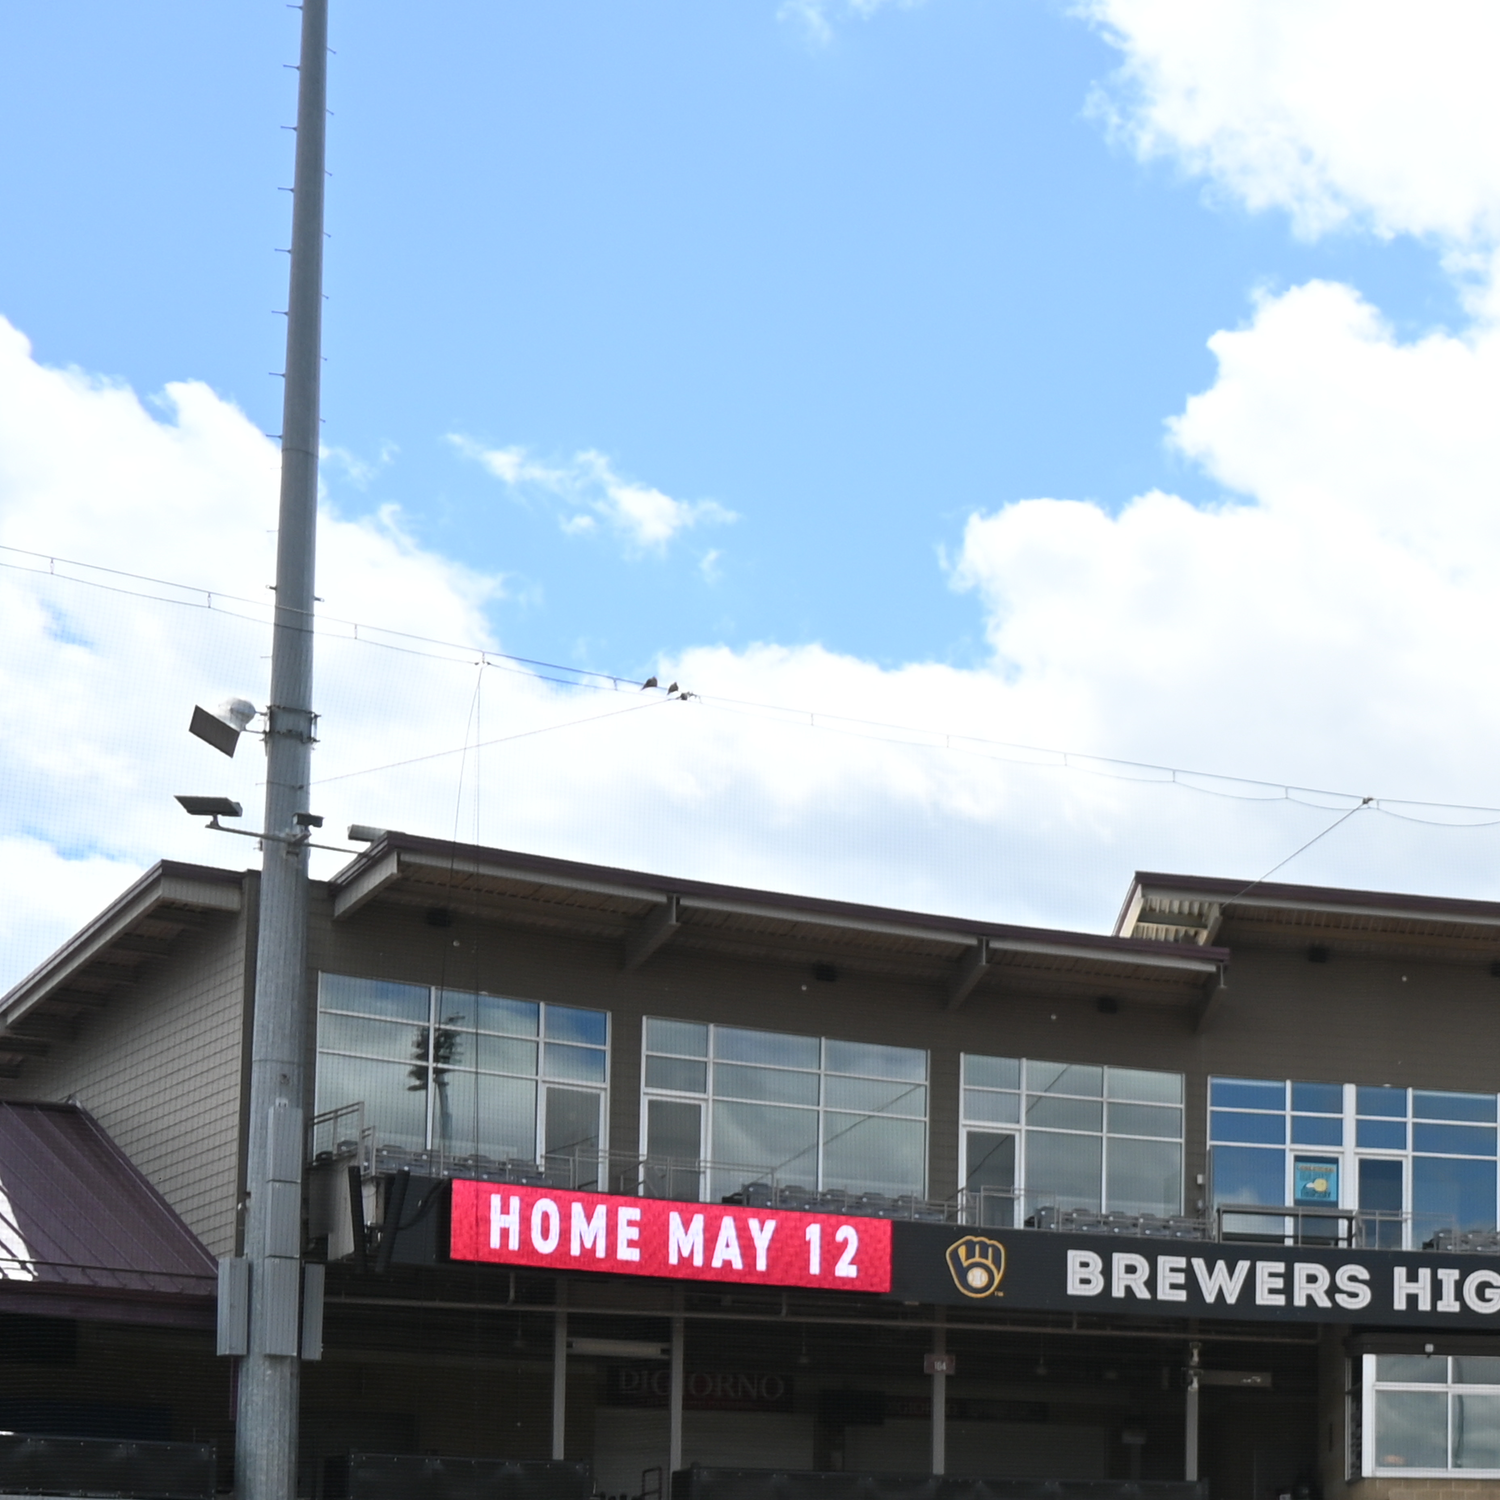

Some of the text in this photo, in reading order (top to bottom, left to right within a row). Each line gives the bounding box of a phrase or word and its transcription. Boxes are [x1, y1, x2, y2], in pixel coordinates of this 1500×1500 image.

[489, 1193, 859, 1279] HOME MAY 12
[1066, 1249, 1372, 1310] BREWERS
